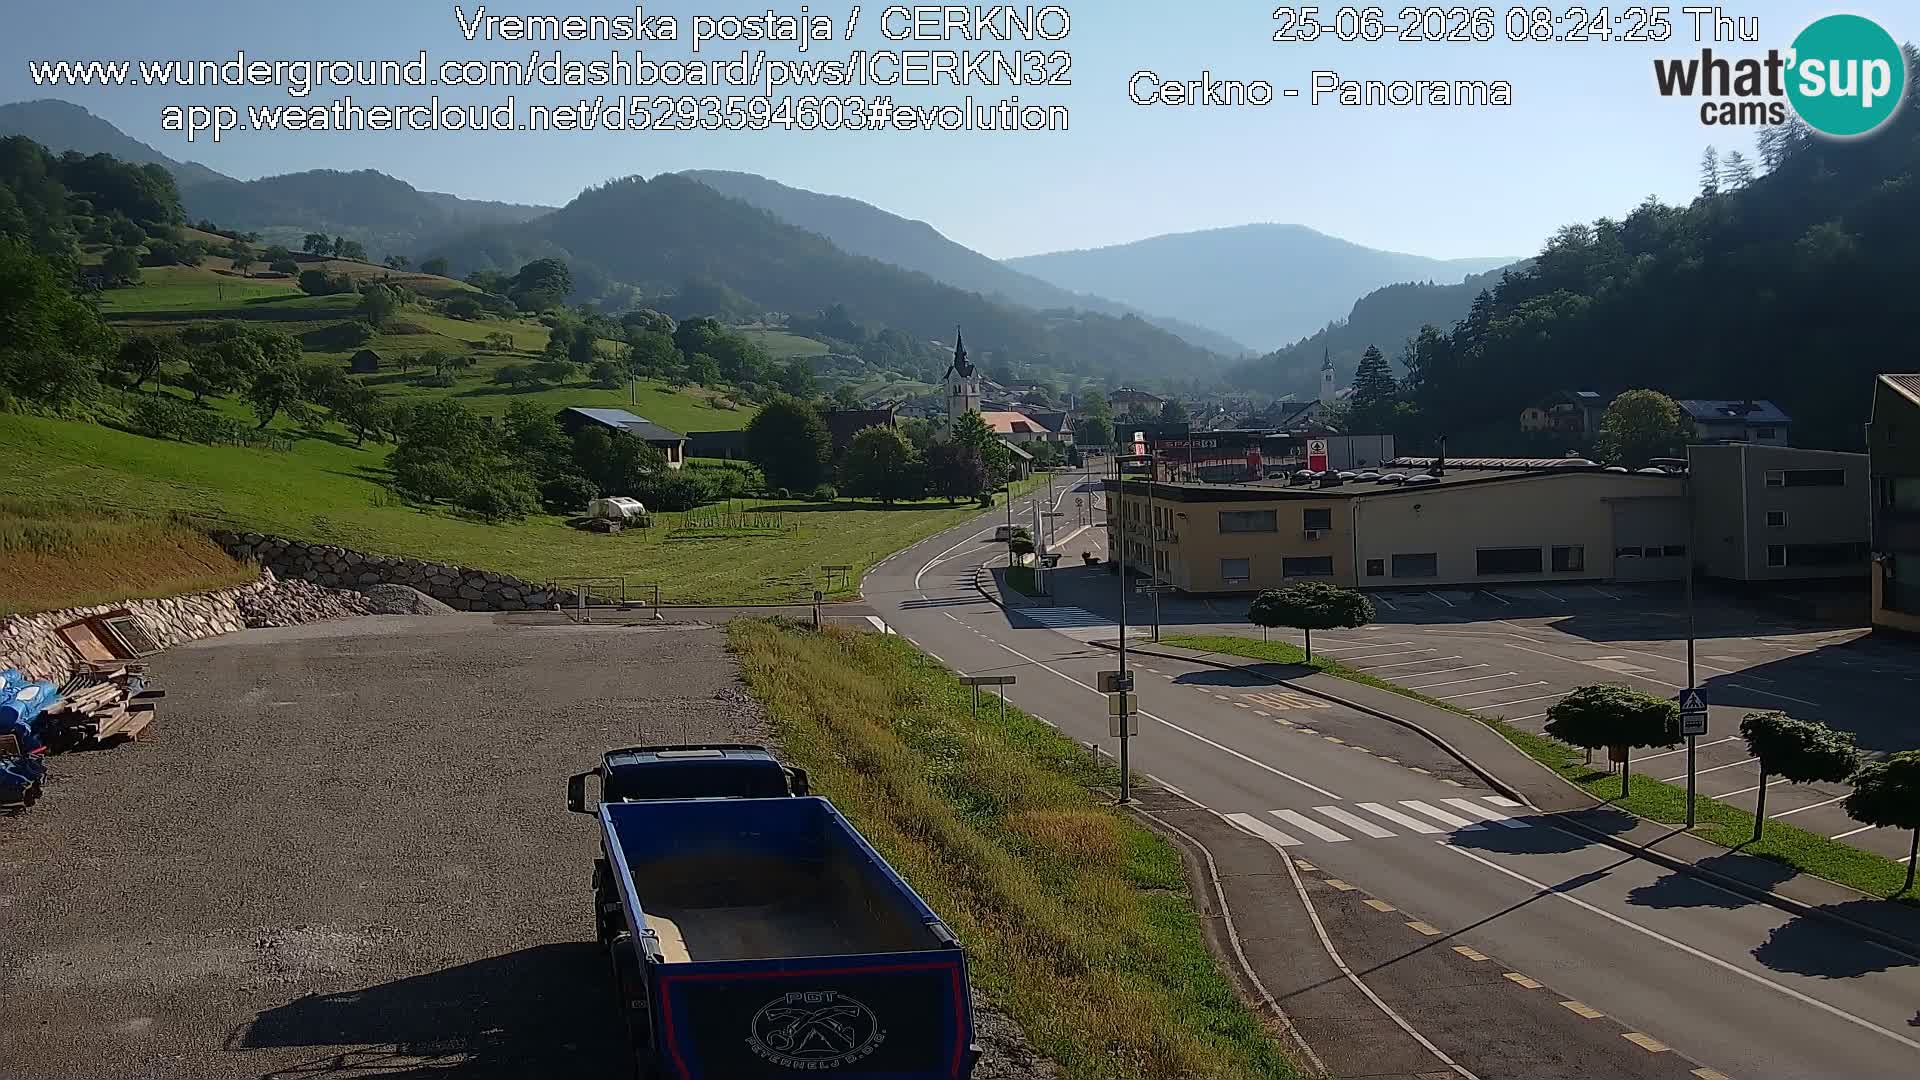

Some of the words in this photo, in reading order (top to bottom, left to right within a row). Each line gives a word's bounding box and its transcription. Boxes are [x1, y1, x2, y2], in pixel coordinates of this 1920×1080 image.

[1166, 440, 1202, 449] SPAR
[1239, 692, 1333, 711] BUS
[784, 990, 838, 1006] PGT
[744, 1036, 841, 1071] PETERNELJ
